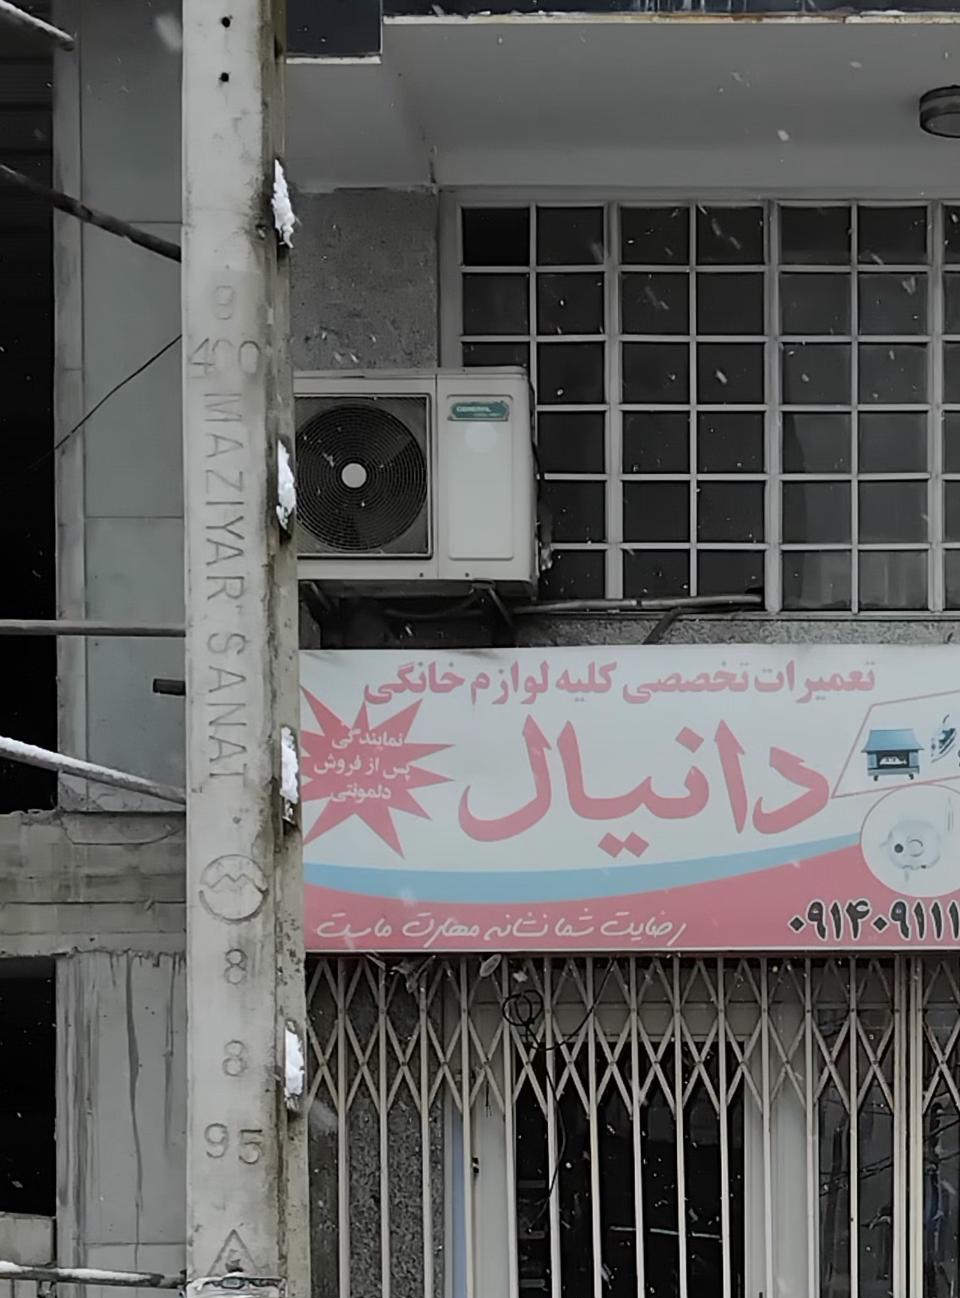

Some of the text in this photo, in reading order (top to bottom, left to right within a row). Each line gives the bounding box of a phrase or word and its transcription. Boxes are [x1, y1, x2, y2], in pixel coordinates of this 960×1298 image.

[203, 392, 249, 788] MAZIYAR SANAT
[362, 659, 876, 705] تعمیرات تخصصی کلیه لوازم خانگی
[331, 728, 403, 750] نمایندگی
[313, 753, 411, 782] پس از فروش
[459, 713, 830, 858] دانیال
[330, 782, 392, 804] دلمونتی
[316, 907, 687, 948] رضایت شما نشانه مهارت ماست
[203, 1122, 263, 1165] 95
